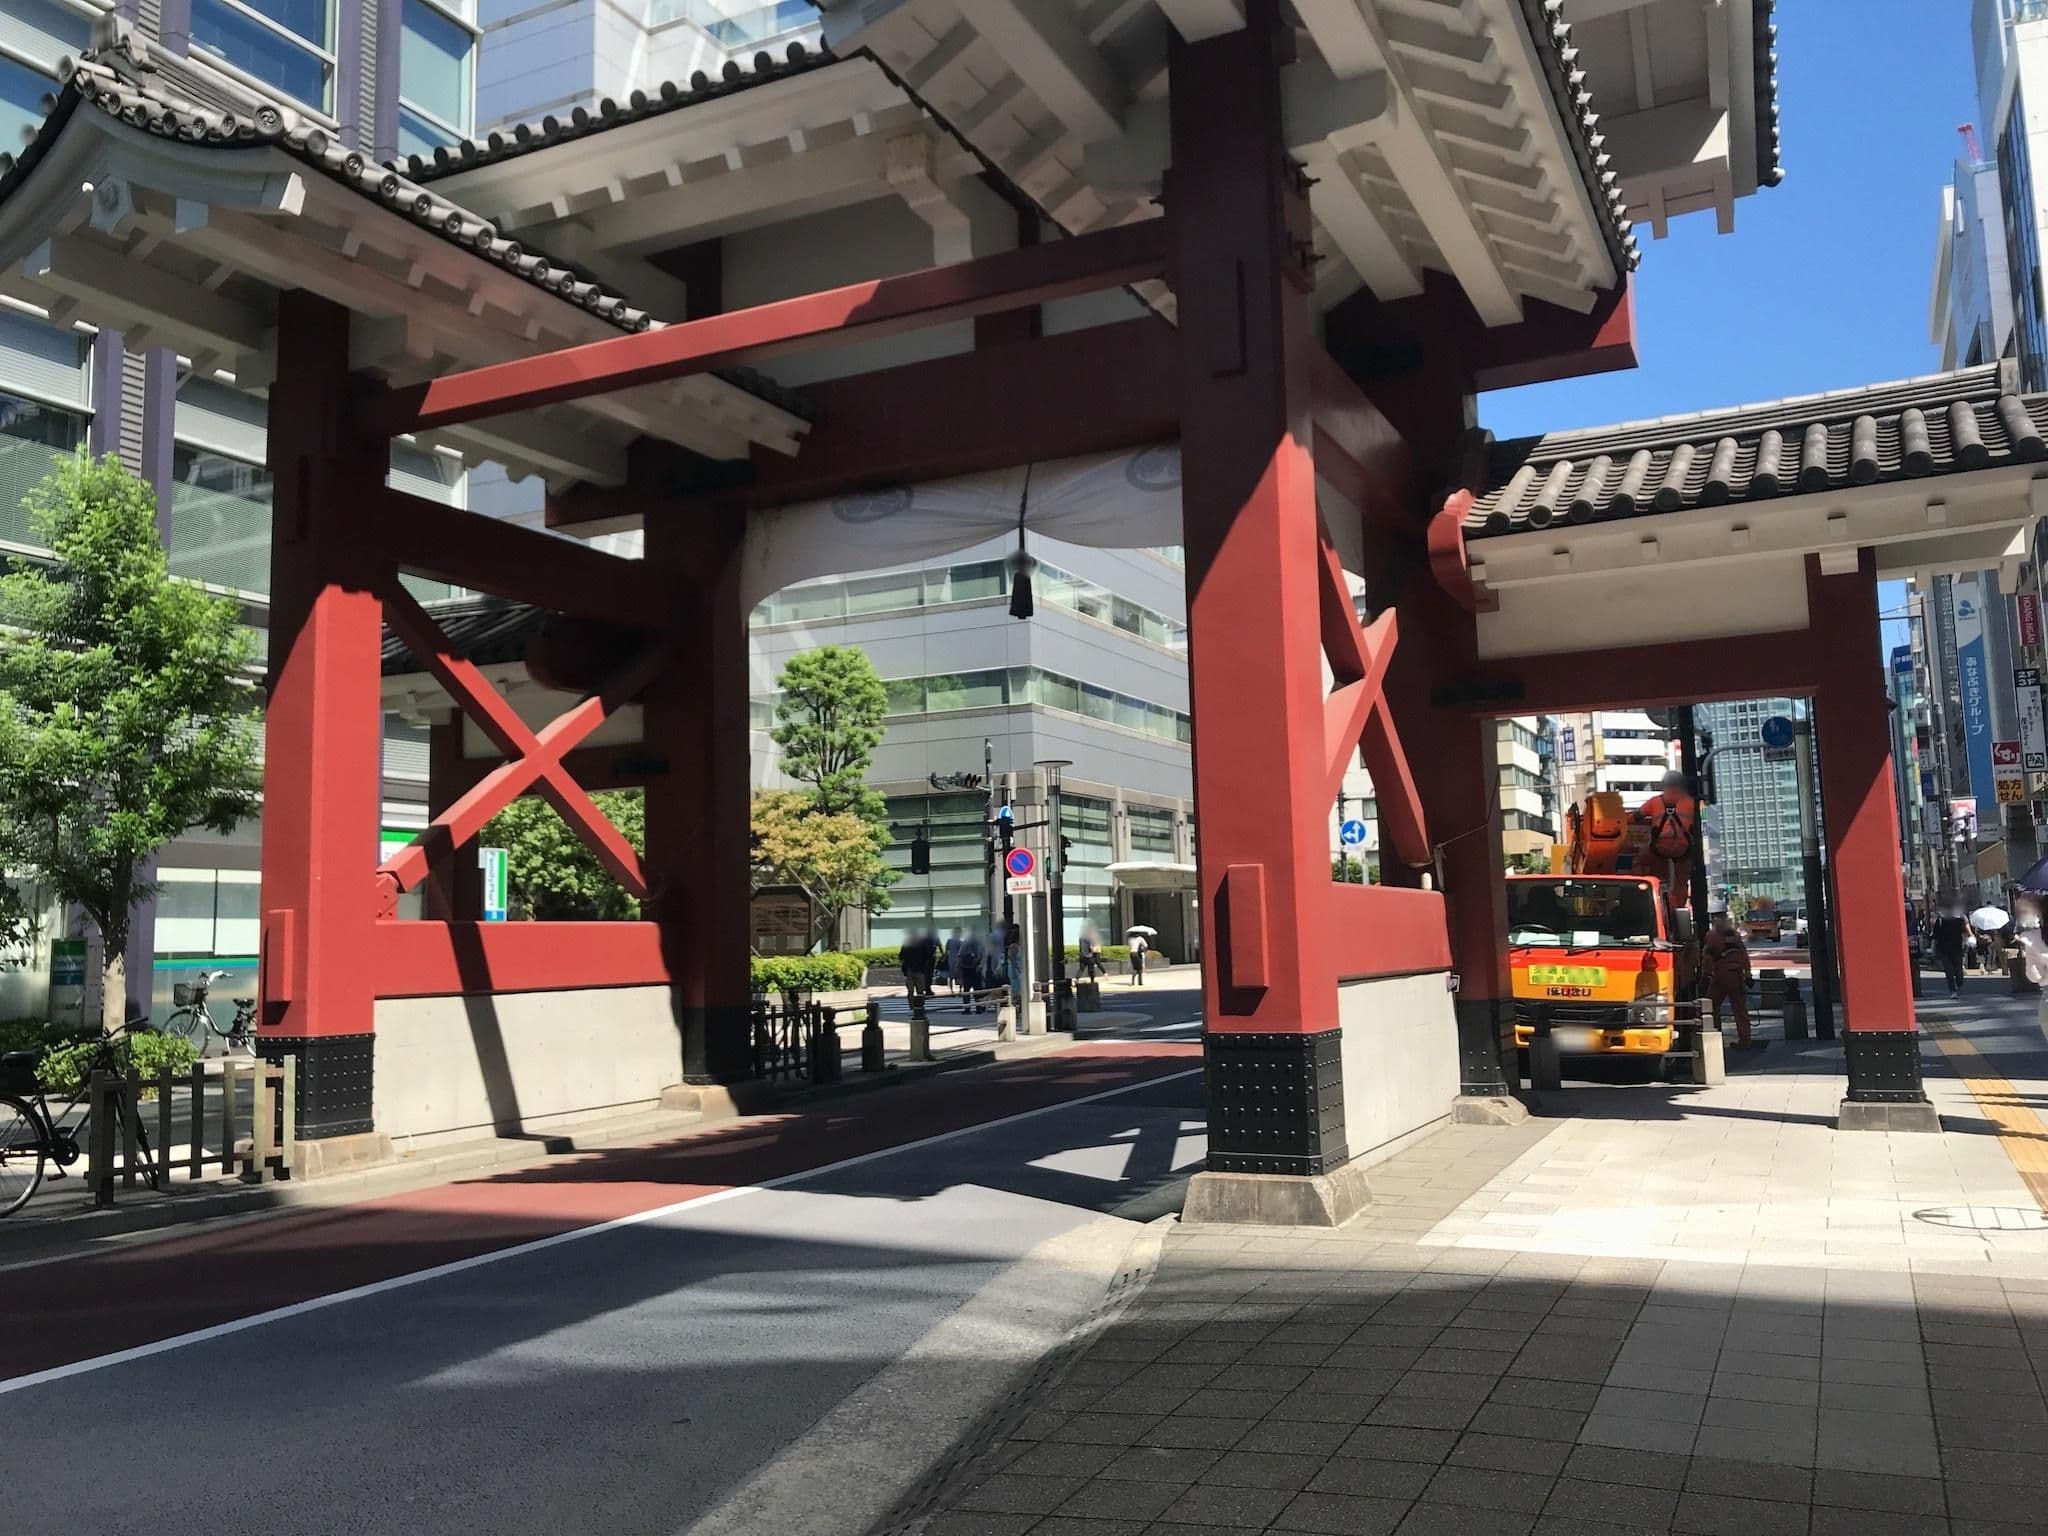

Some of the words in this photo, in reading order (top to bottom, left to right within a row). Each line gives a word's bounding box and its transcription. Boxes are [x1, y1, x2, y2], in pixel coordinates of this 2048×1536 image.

[2017, 670, 2036, 679] 2F
[2018, 678, 2037, 687] 3F
[1965, 656, 1984, 735] あなぶきグループ
[1994, 743, 2020, 763] くすり
[1998, 780, 2022, 791] 処方
[2000, 791, 2023, 801] せん
[1547, 987, 1592, 997] ISUZU
